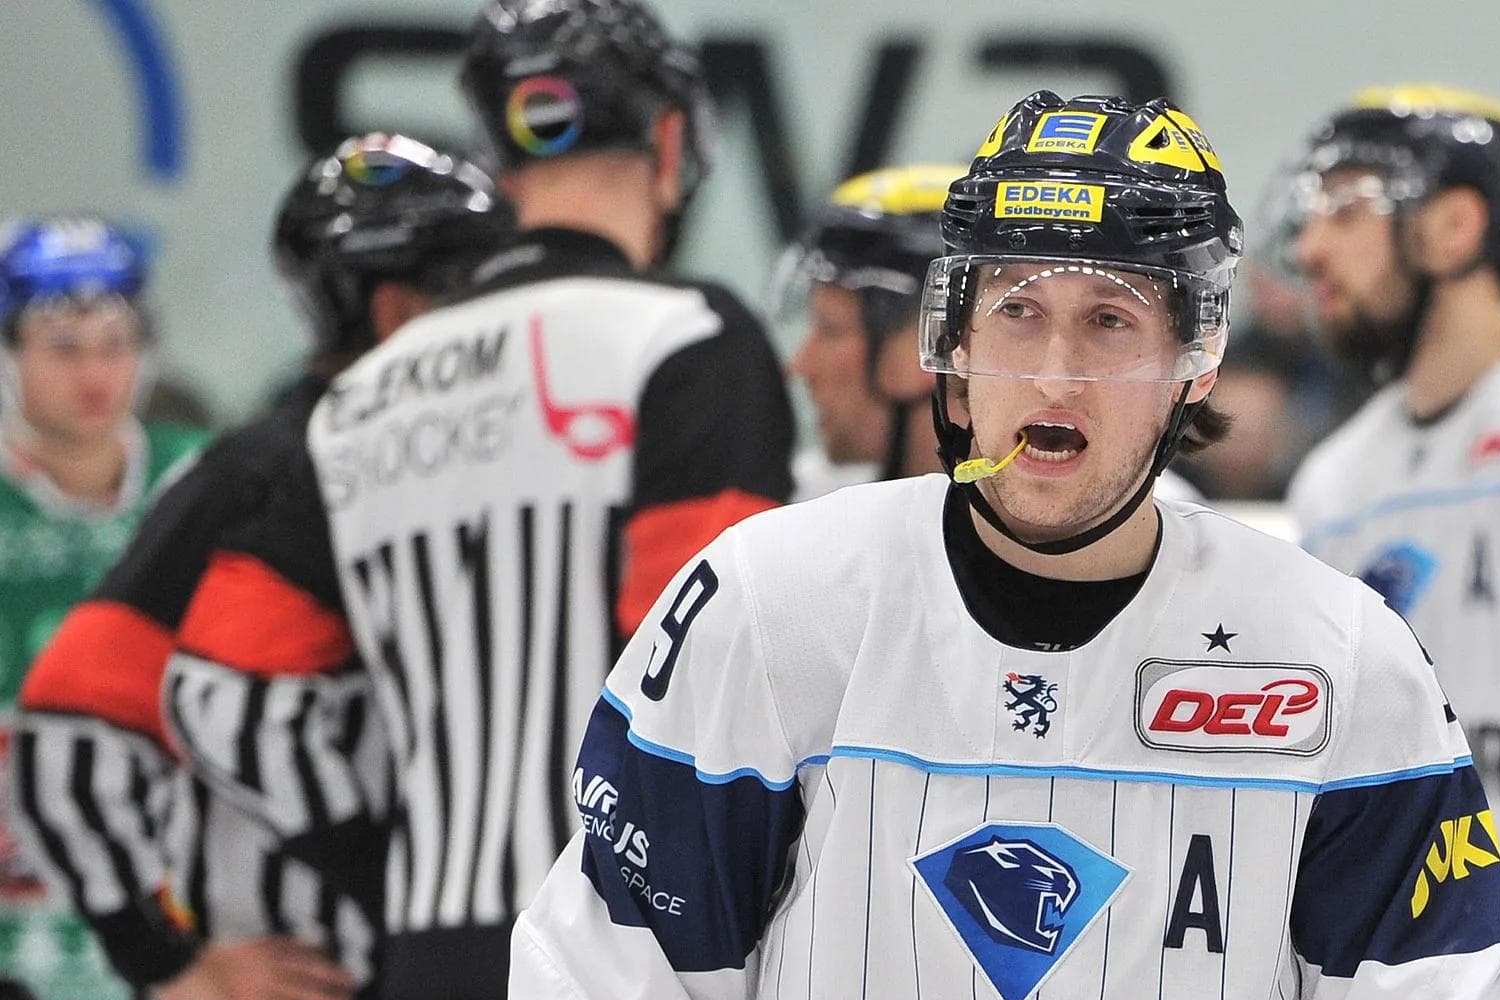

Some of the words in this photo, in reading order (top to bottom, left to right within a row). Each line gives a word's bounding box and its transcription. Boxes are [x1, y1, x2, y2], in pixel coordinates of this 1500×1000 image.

[1033, 140, 1088, 150] EDEKA
[1004, 185, 1092, 205] EDEKA
[1004, 205, 1090, 219] Südbayern
[1163, 833, 1225, 954] A
